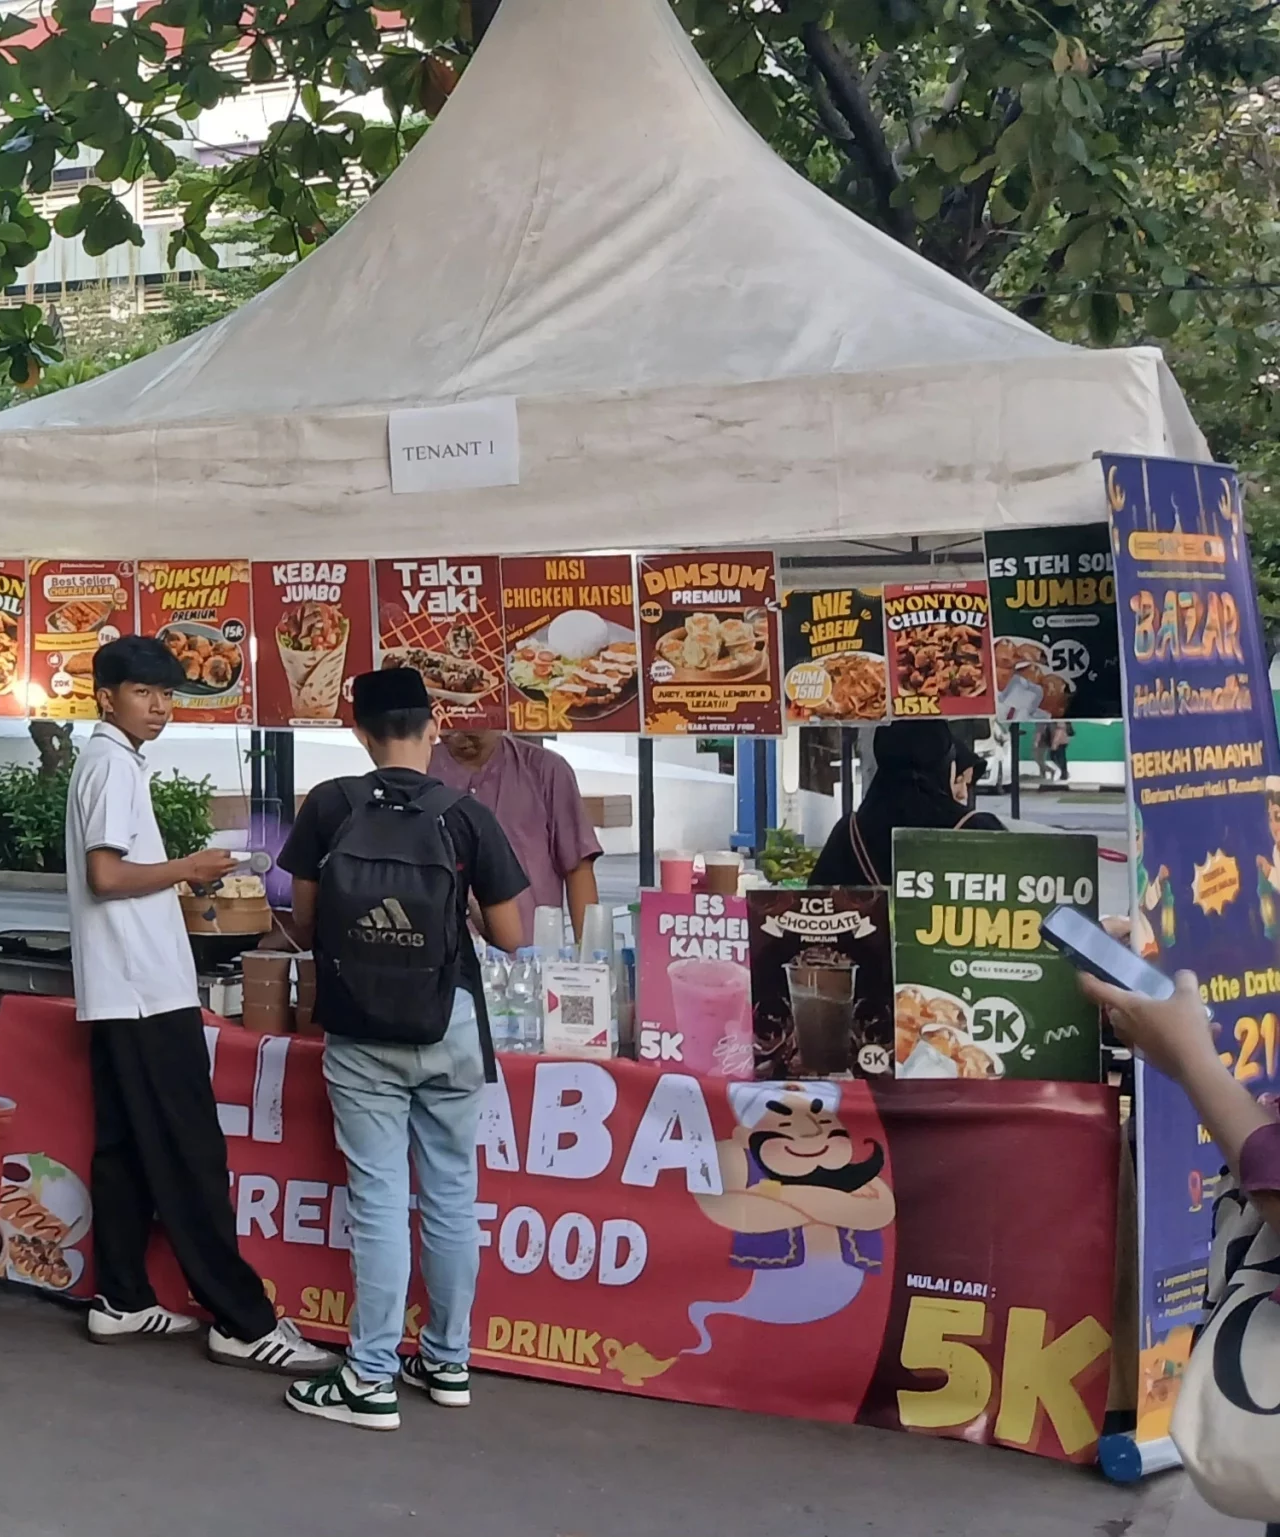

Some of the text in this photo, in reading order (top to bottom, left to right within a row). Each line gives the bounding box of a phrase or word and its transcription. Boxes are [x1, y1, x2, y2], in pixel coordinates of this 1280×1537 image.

[402, 441, 482, 461] TENANT
[154, 564, 233, 590] DIMSUM
[272, 562, 347, 586] KEBAB
[393, 558, 483, 587] Tako
[545, 559, 586, 581] NASI
[989, 552, 1114, 578] ES TEH SOL
[51, 575, 112, 587] Best Seller
[643, 563, 766, 596] DIMSUM
[161, 588, 228, 610] MENTAI
[282, 584, 341, 603] JUMBO
[401, 586, 478, 614] Yaki
[503, 585, 632, 608] CHICKEN KATSU
[672, 589, 741, 605] PREMIUM
[1006, 575, 1117, 609] JUMBO
[172, 610, 217, 621] PREMIUM
[812, 590, 853, 620] MIE
[885, 593, 989, 616] WONTON
[809, 619, 860, 645] JEBEW
[888, 609, 987, 631] CHILI OIL
[1051, 646, 1086, 673] 5K
[790, 670, 826, 684] CUMA
[508, 700, 573, 731] 15K
[893, 695, 941, 716] 15K
[1131, 747, 1192, 779] BERKAH
[896, 871, 1094, 904] ES TEH SOLO
[695, 894, 725, 916] ES
[800, 897, 835, 914] ICE
[777, 914, 860, 931] CHOCOLATE
[915, 904, 1043, 950] JUMB
[347, 927, 425, 948] adidas
[670, 937, 750, 962] KARET
[972, 965, 992, 973] BELI
[1210, 974, 1240, 1003] the
[972, 1008, 1019, 1044] 5K
[640, 1030, 684, 1062] 5K
[862, 1051, 886, 1066] 5K
[906, 1273, 951, 1292] MULAI
[953, 1280, 988, 1297] DARI
[487, 1316, 601, 1366] DRINK
[896, 1295, 1113, 1456] 5K
